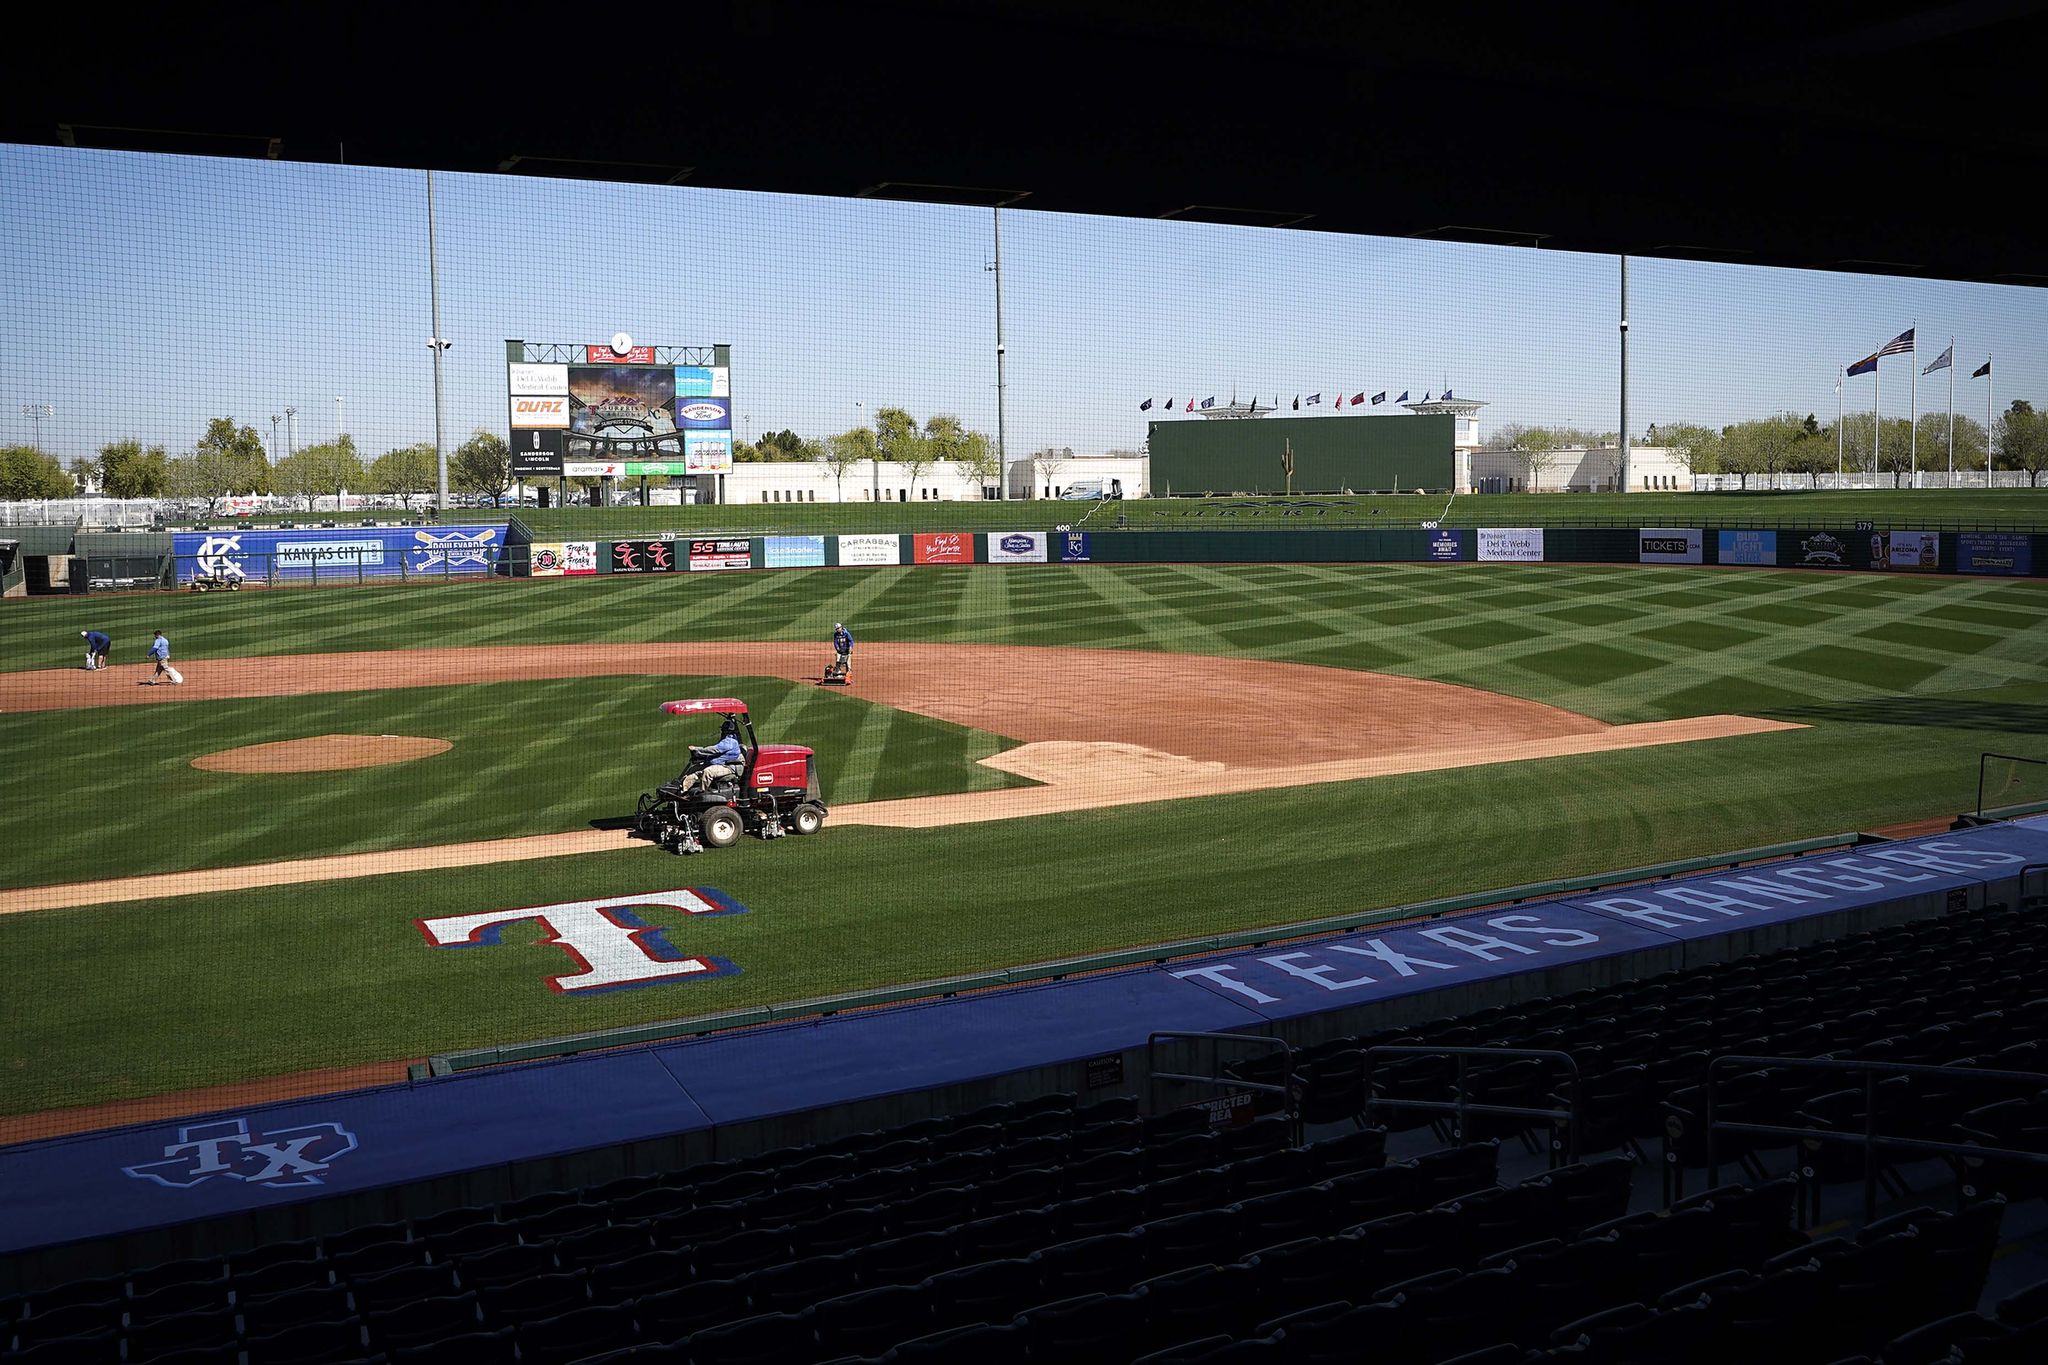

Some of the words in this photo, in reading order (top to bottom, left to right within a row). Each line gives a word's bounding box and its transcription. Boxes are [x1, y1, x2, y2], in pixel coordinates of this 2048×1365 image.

[684, 406, 722, 414] SANDERSON
[1737, 533, 1759, 541] BUD
[840, 538, 898, 548] CARRABBA'S
[1070, 541, 1081, 551] KC
[1734, 542, 1763, 552] LIGHT
[284, 547, 333, 561] KANSAS
[337, 546, 364, 560] CITY
[566, 544, 589, 553] Freaky
[926, 545, 939, 554] Your
[940, 543, 960, 554] Surprise
[567, 556, 590, 566] Freaky
[1172, 914, 1600, 1004] TEXAS
[1588, 841, 2024, 929] RANGERS
